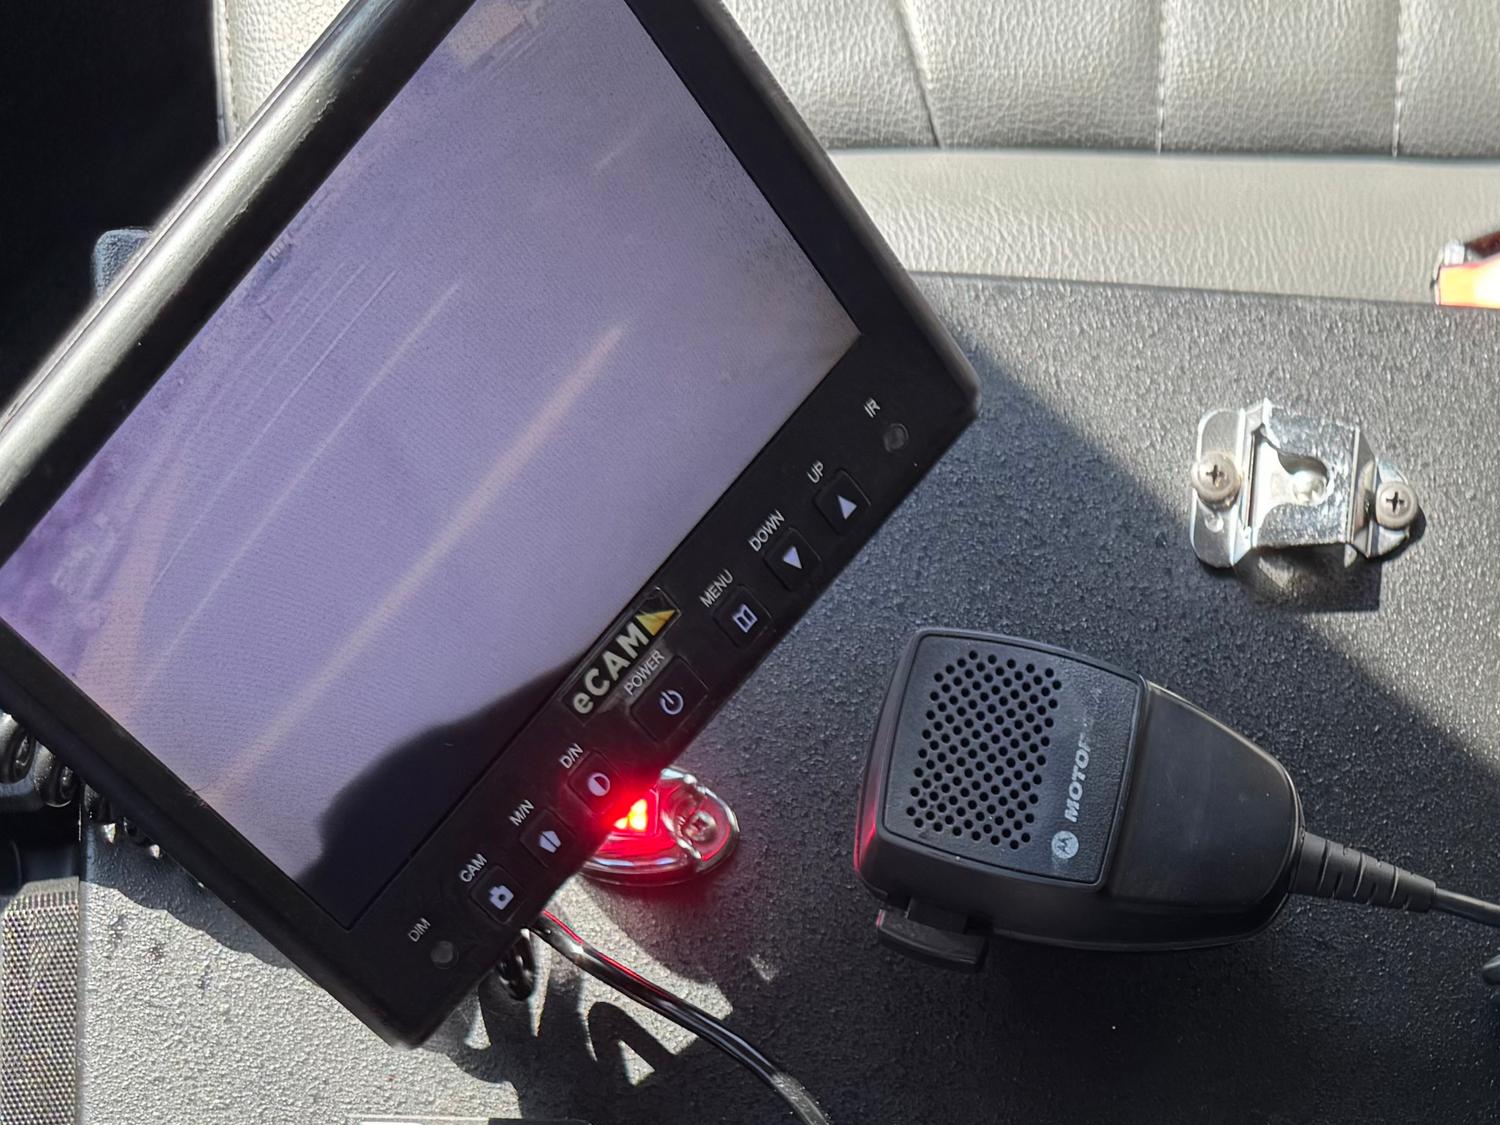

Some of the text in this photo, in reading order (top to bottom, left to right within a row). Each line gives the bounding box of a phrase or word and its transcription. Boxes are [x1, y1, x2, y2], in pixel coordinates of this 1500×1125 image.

[864, 398, 881, 418] IR
[806, 460, 824, 483] UP
[748, 510, 785, 551] DOWN
[700, 569, 734, 608] MENU
[573, 622, 650, 715] eCAM
[624, 650, 665, 695] POWER
[559, 743, 584, 769] D/N
[509, 800, 534, 827] M/N
[459, 853, 488, 883] CAM
[408, 918, 431, 942] DIM
